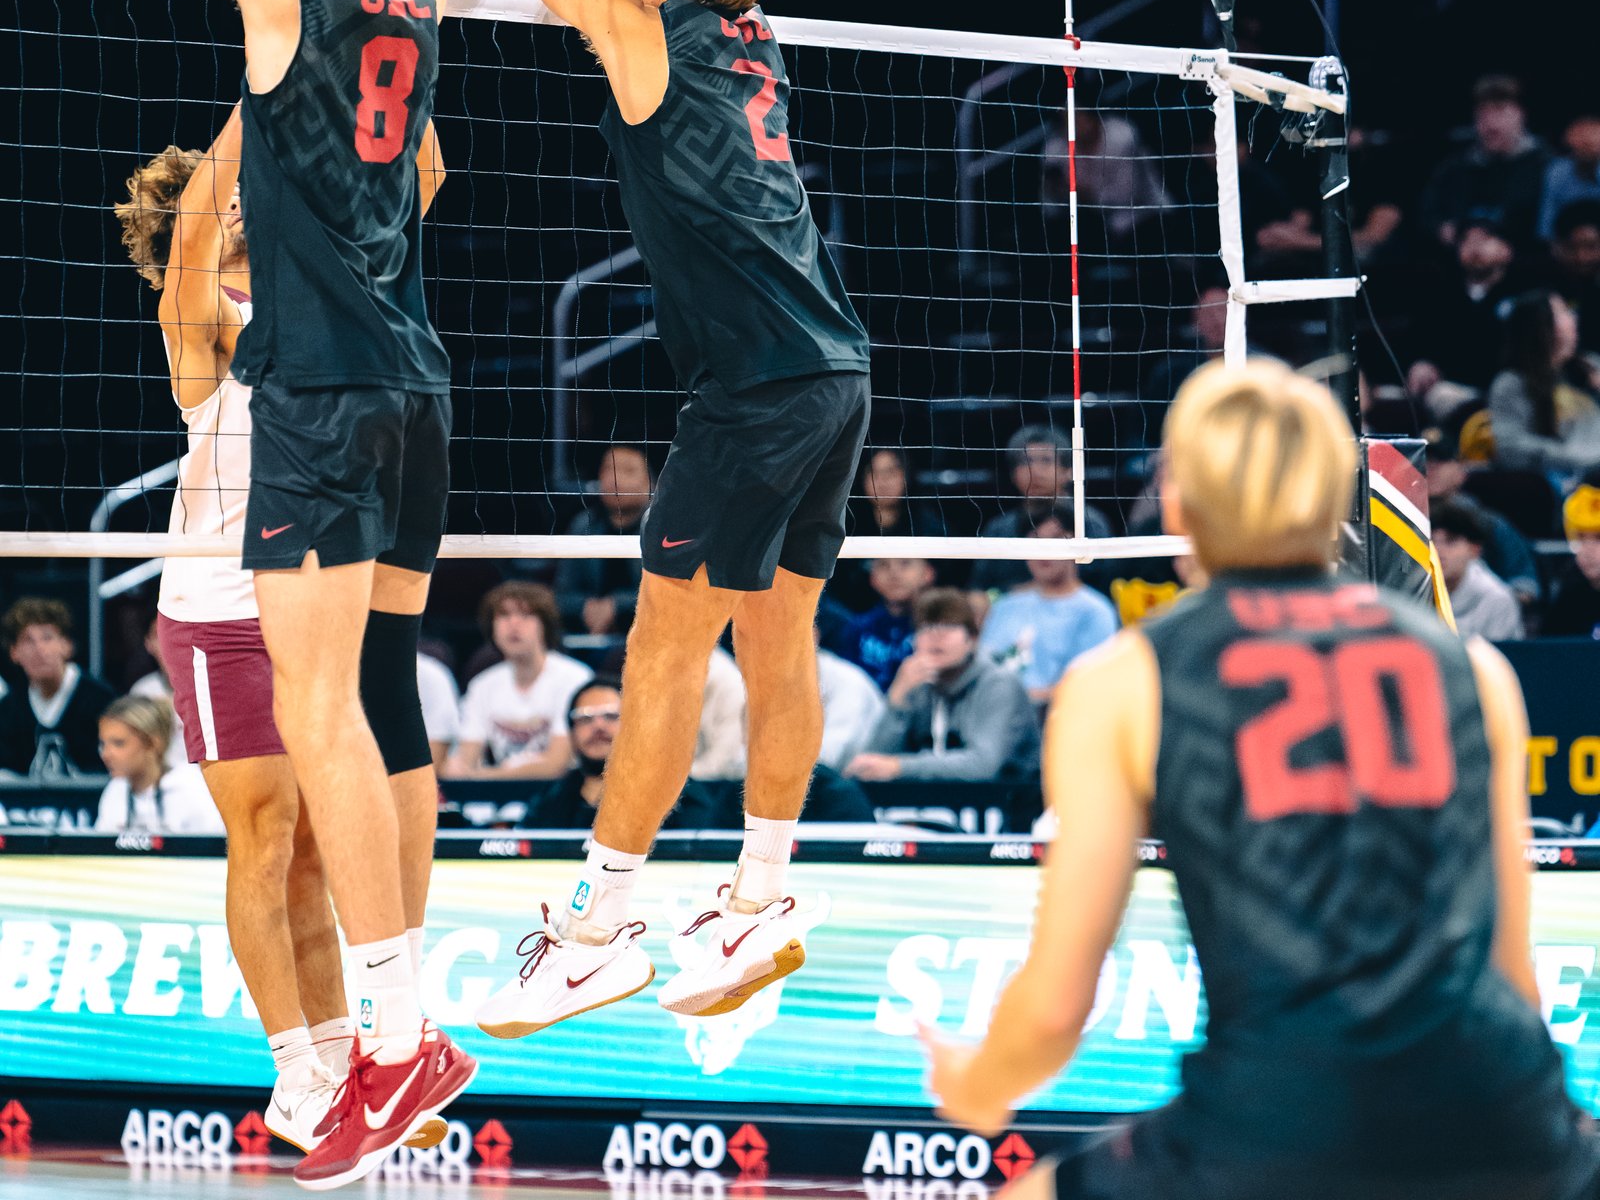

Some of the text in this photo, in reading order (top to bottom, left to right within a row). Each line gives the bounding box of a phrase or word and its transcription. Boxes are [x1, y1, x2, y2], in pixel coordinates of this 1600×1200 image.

[355, 36, 419, 163] 8
[731, 58, 790, 161] 2
[1217, 636, 1456, 821] 20
[121, 1109, 233, 1152] ARCO
[602, 1122, 727, 1169] ARCO
[862, 1131, 992, 1179] ARCO
